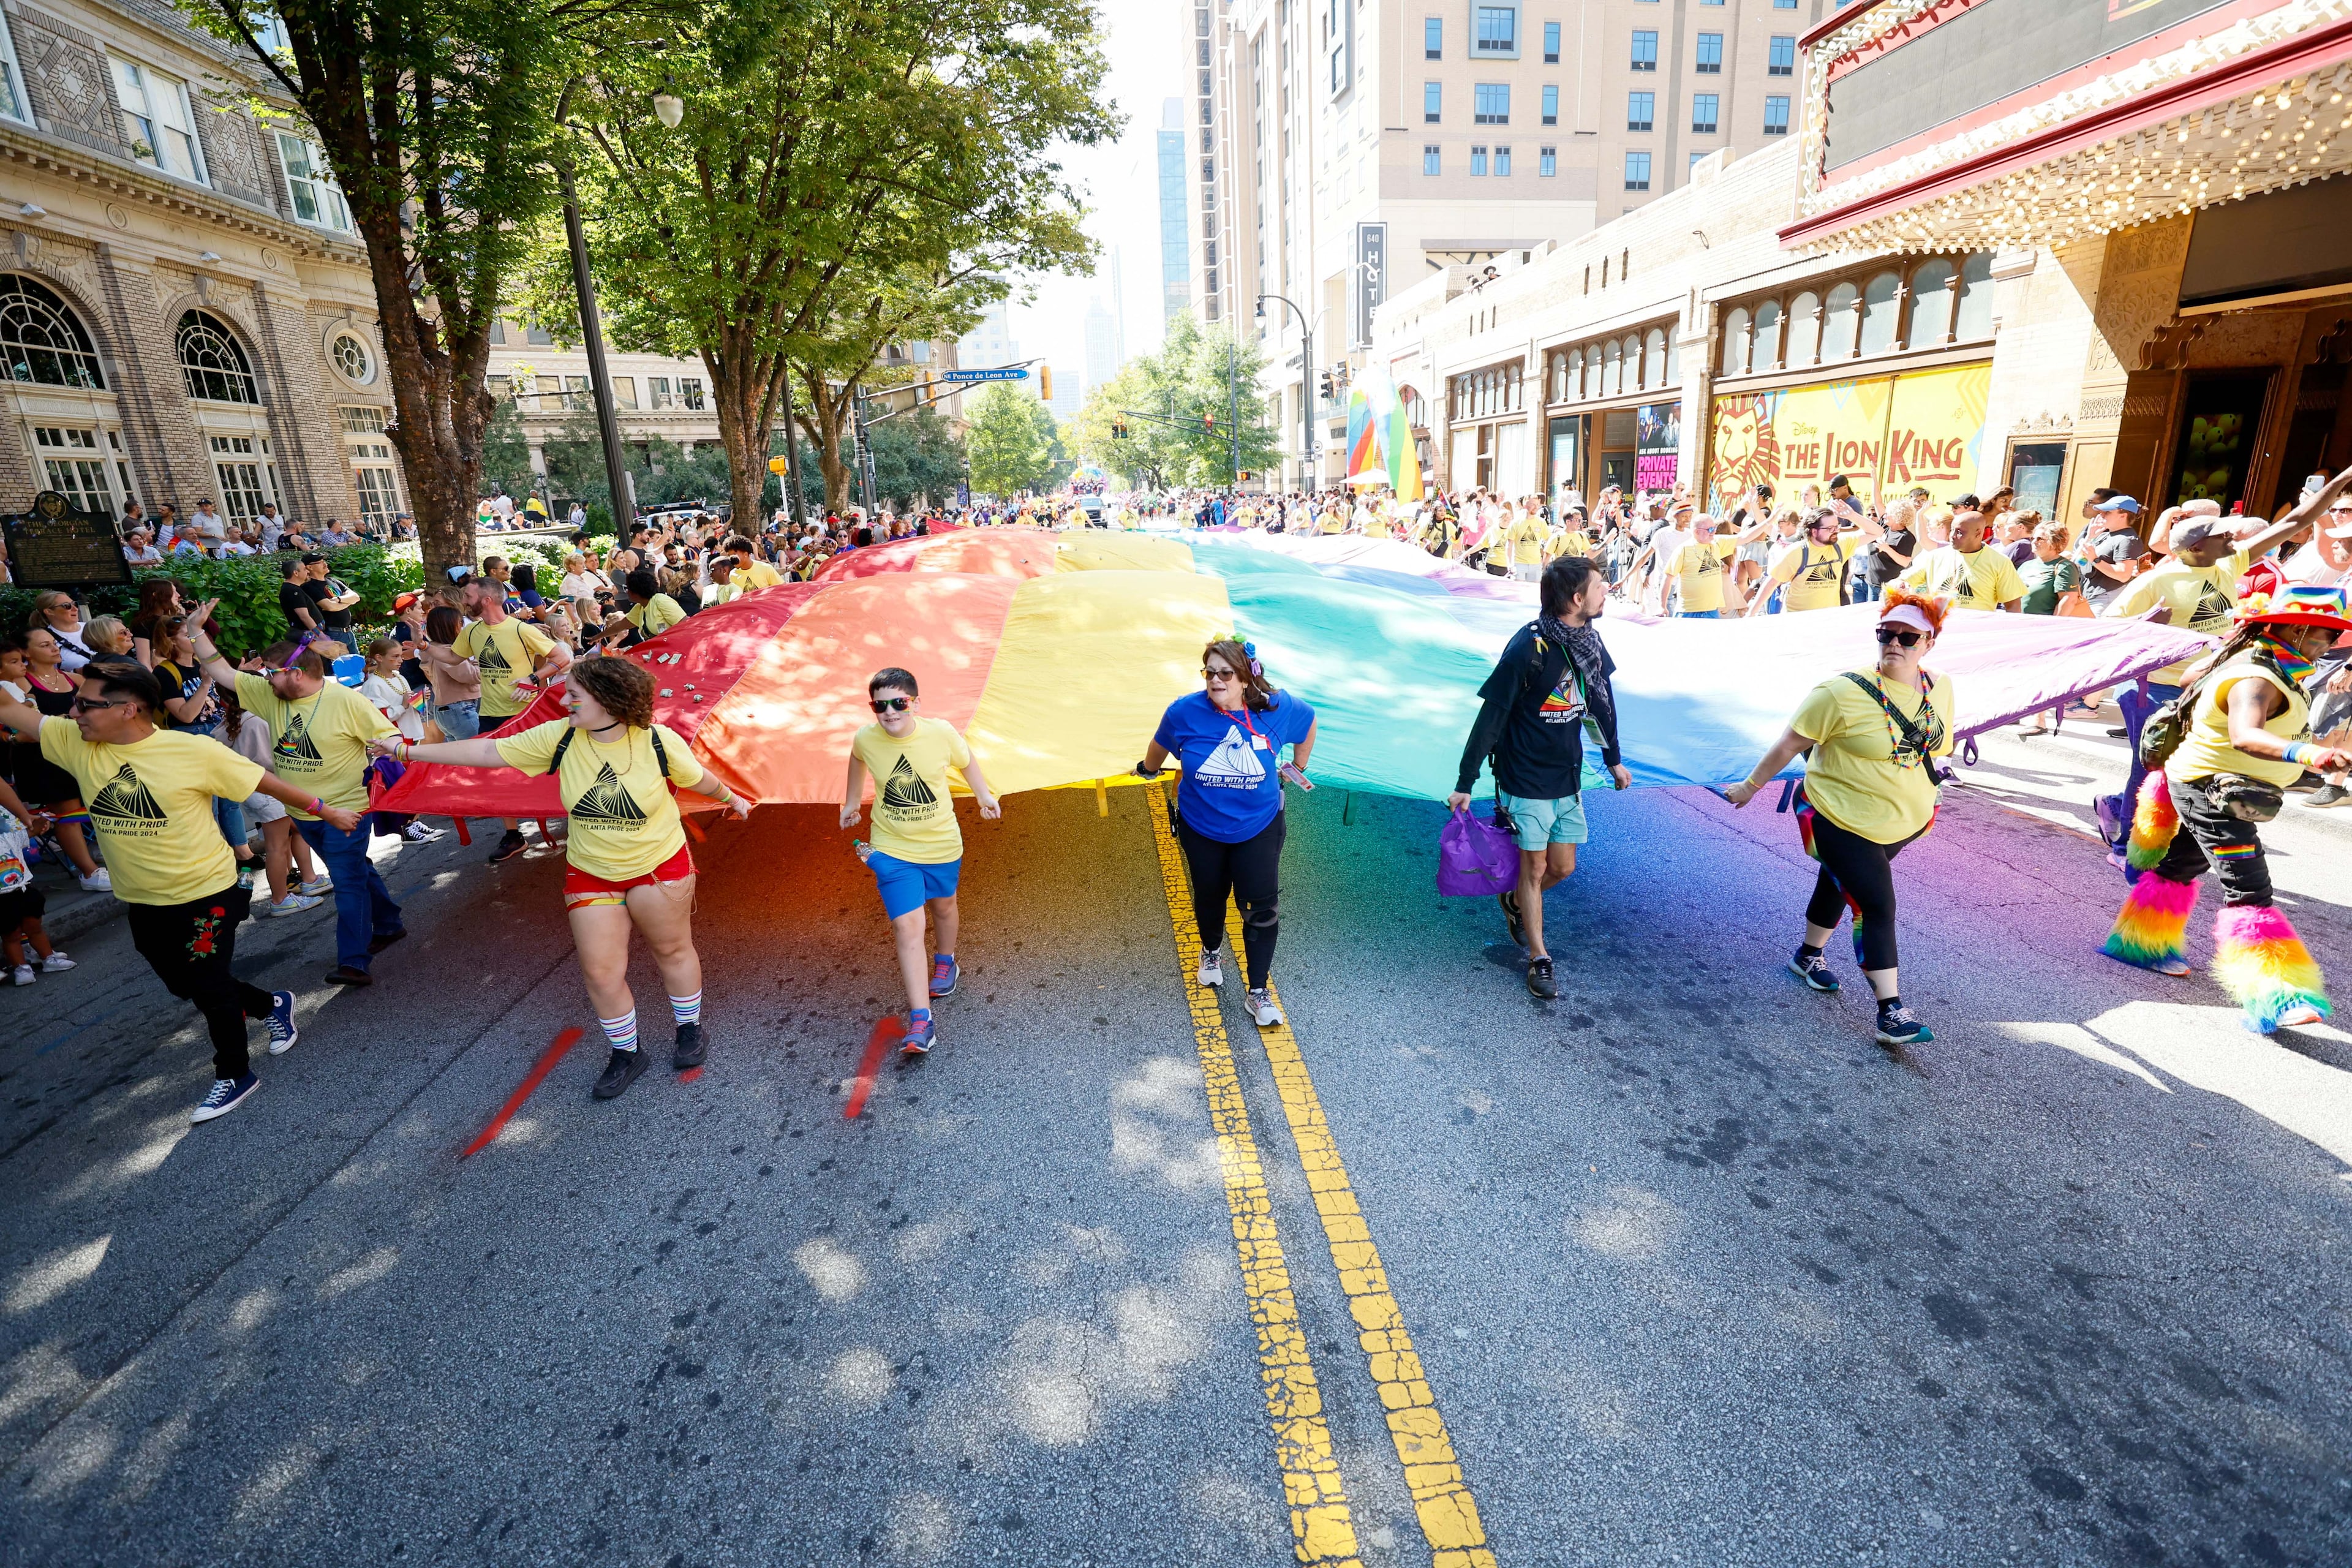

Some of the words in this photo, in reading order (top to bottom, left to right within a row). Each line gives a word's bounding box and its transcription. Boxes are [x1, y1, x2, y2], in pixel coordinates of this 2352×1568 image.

[1366, 234, 1379, 243] 640
[1638, 455, 1678, 471] PRIVATE
[1785, 443, 1820, 469] THE
[1823, 432, 1880, 481] LION
[1887, 429, 1963, 484] KING
[1637, 472, 1676, 489] EVENTS
[2188, 620, 2212, 629] UNITED
[1195, 773, 1222, 782] UNITED
[1245, 774, 1266, 783] PRIDE
[881, 803, 900, 815] UNITED
[922, 802, 939, 813] PRIDE
